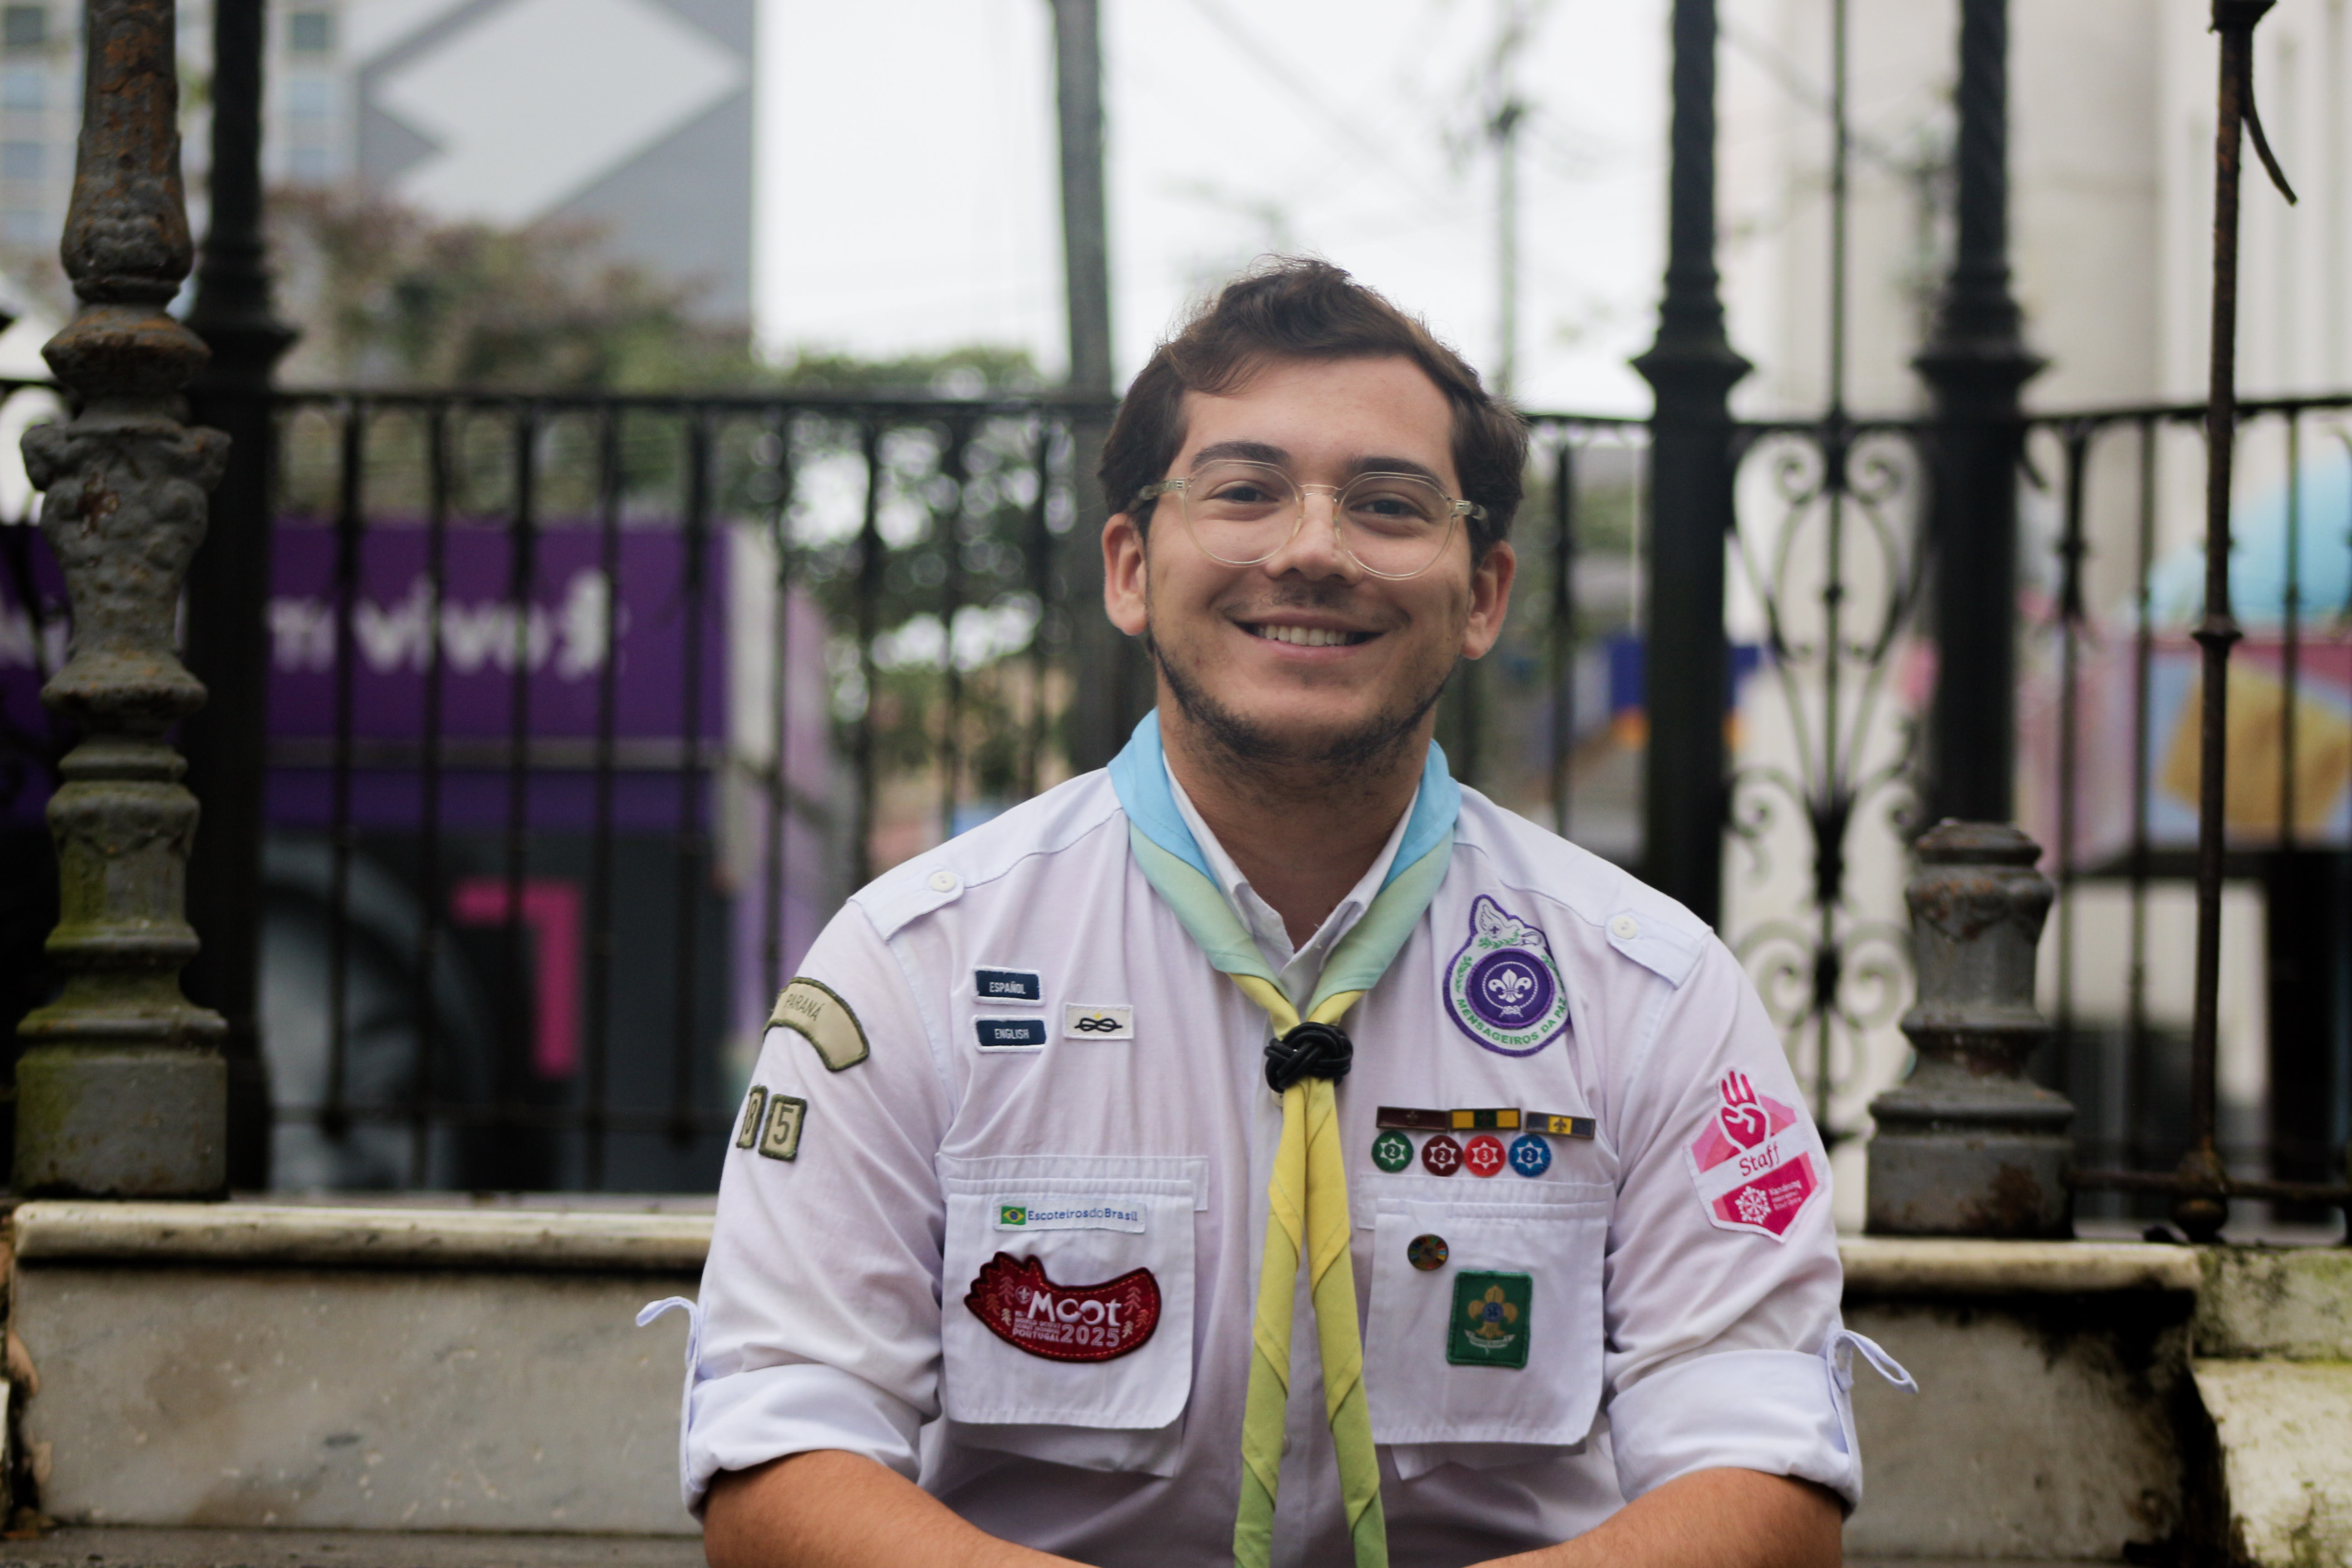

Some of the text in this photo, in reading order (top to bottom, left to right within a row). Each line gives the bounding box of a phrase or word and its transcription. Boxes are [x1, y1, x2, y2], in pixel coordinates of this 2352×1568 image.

[989, 981, 1026, 995] ESPAÑOL
[784, 994, 825, 1021] PARANÁ
[1457, 996, 1568, 1044] MENSAGEIROS DA PAZ
[994, 1028, 1030, 1039] ENGLISH
[1389, 1147, 1396, 1157] 2
[1440, 1151, 1446, 1161] 2
[1482, 1150, 1488, 1160] 3
[1526, 1150, 1533, 1161] 2
[1740, 1142, 1779, 1176] Staff
[1027, 1290, 1122, 1327] Moot
[1012, 1328, 1059, 1342] PORTUGAL
[1060, 1324, 1120, 1347] 2025
